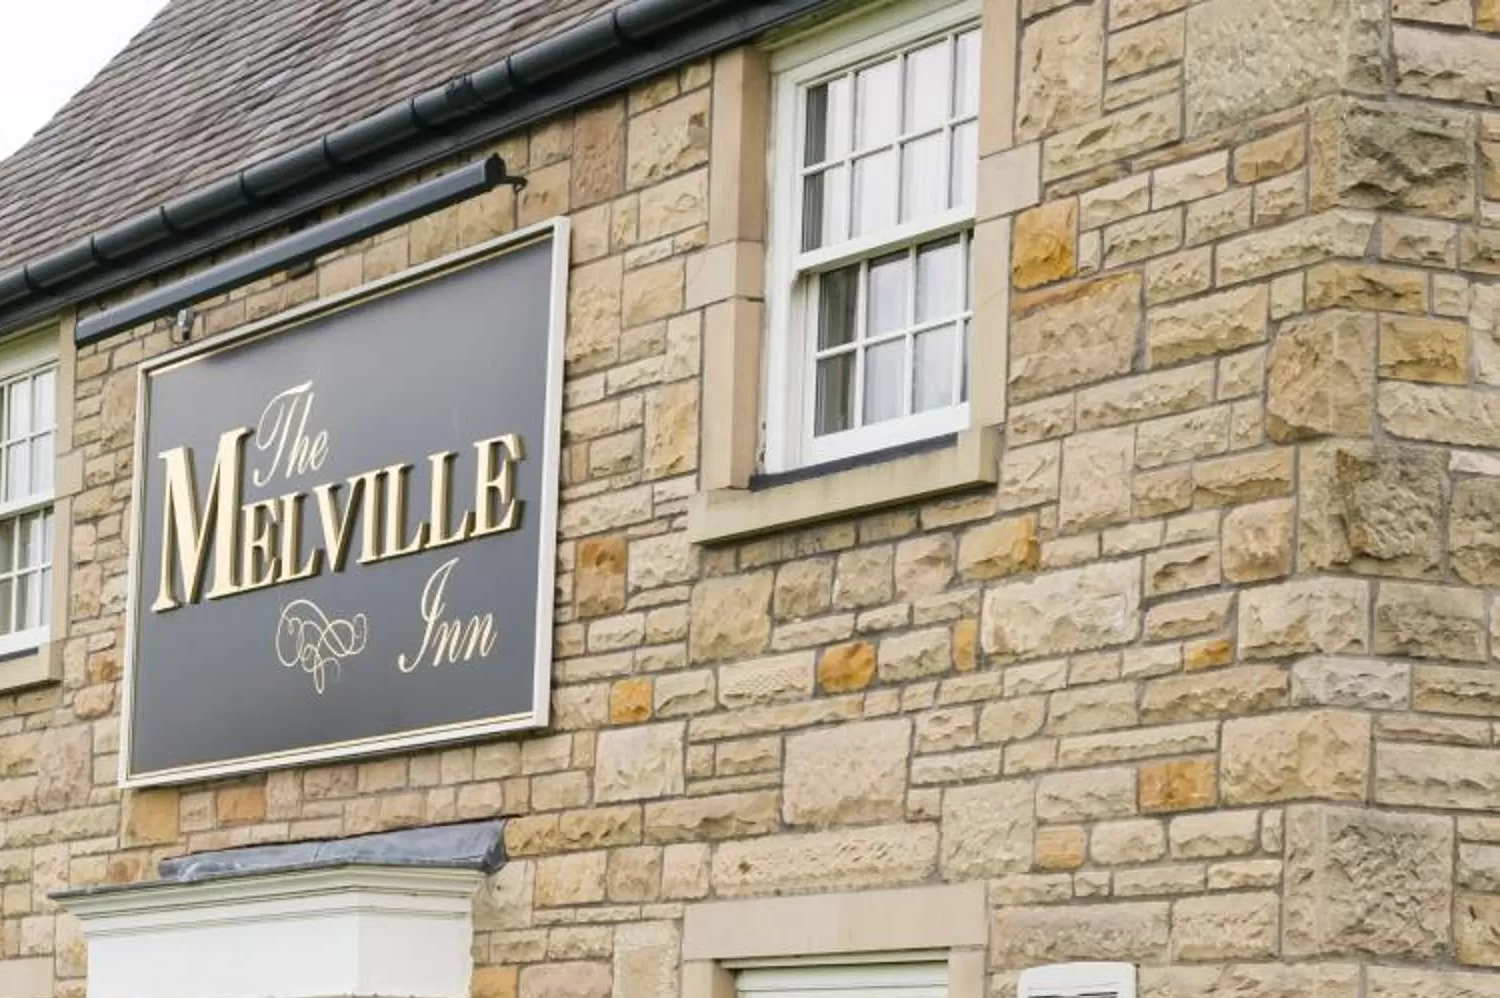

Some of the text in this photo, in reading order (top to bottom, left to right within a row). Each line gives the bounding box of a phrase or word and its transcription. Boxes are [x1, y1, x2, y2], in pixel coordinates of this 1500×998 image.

[253, 380, 329, 488] The
[151, 427, 526, 613] MELVILLE
[398, 557, 497, 672] Inn
